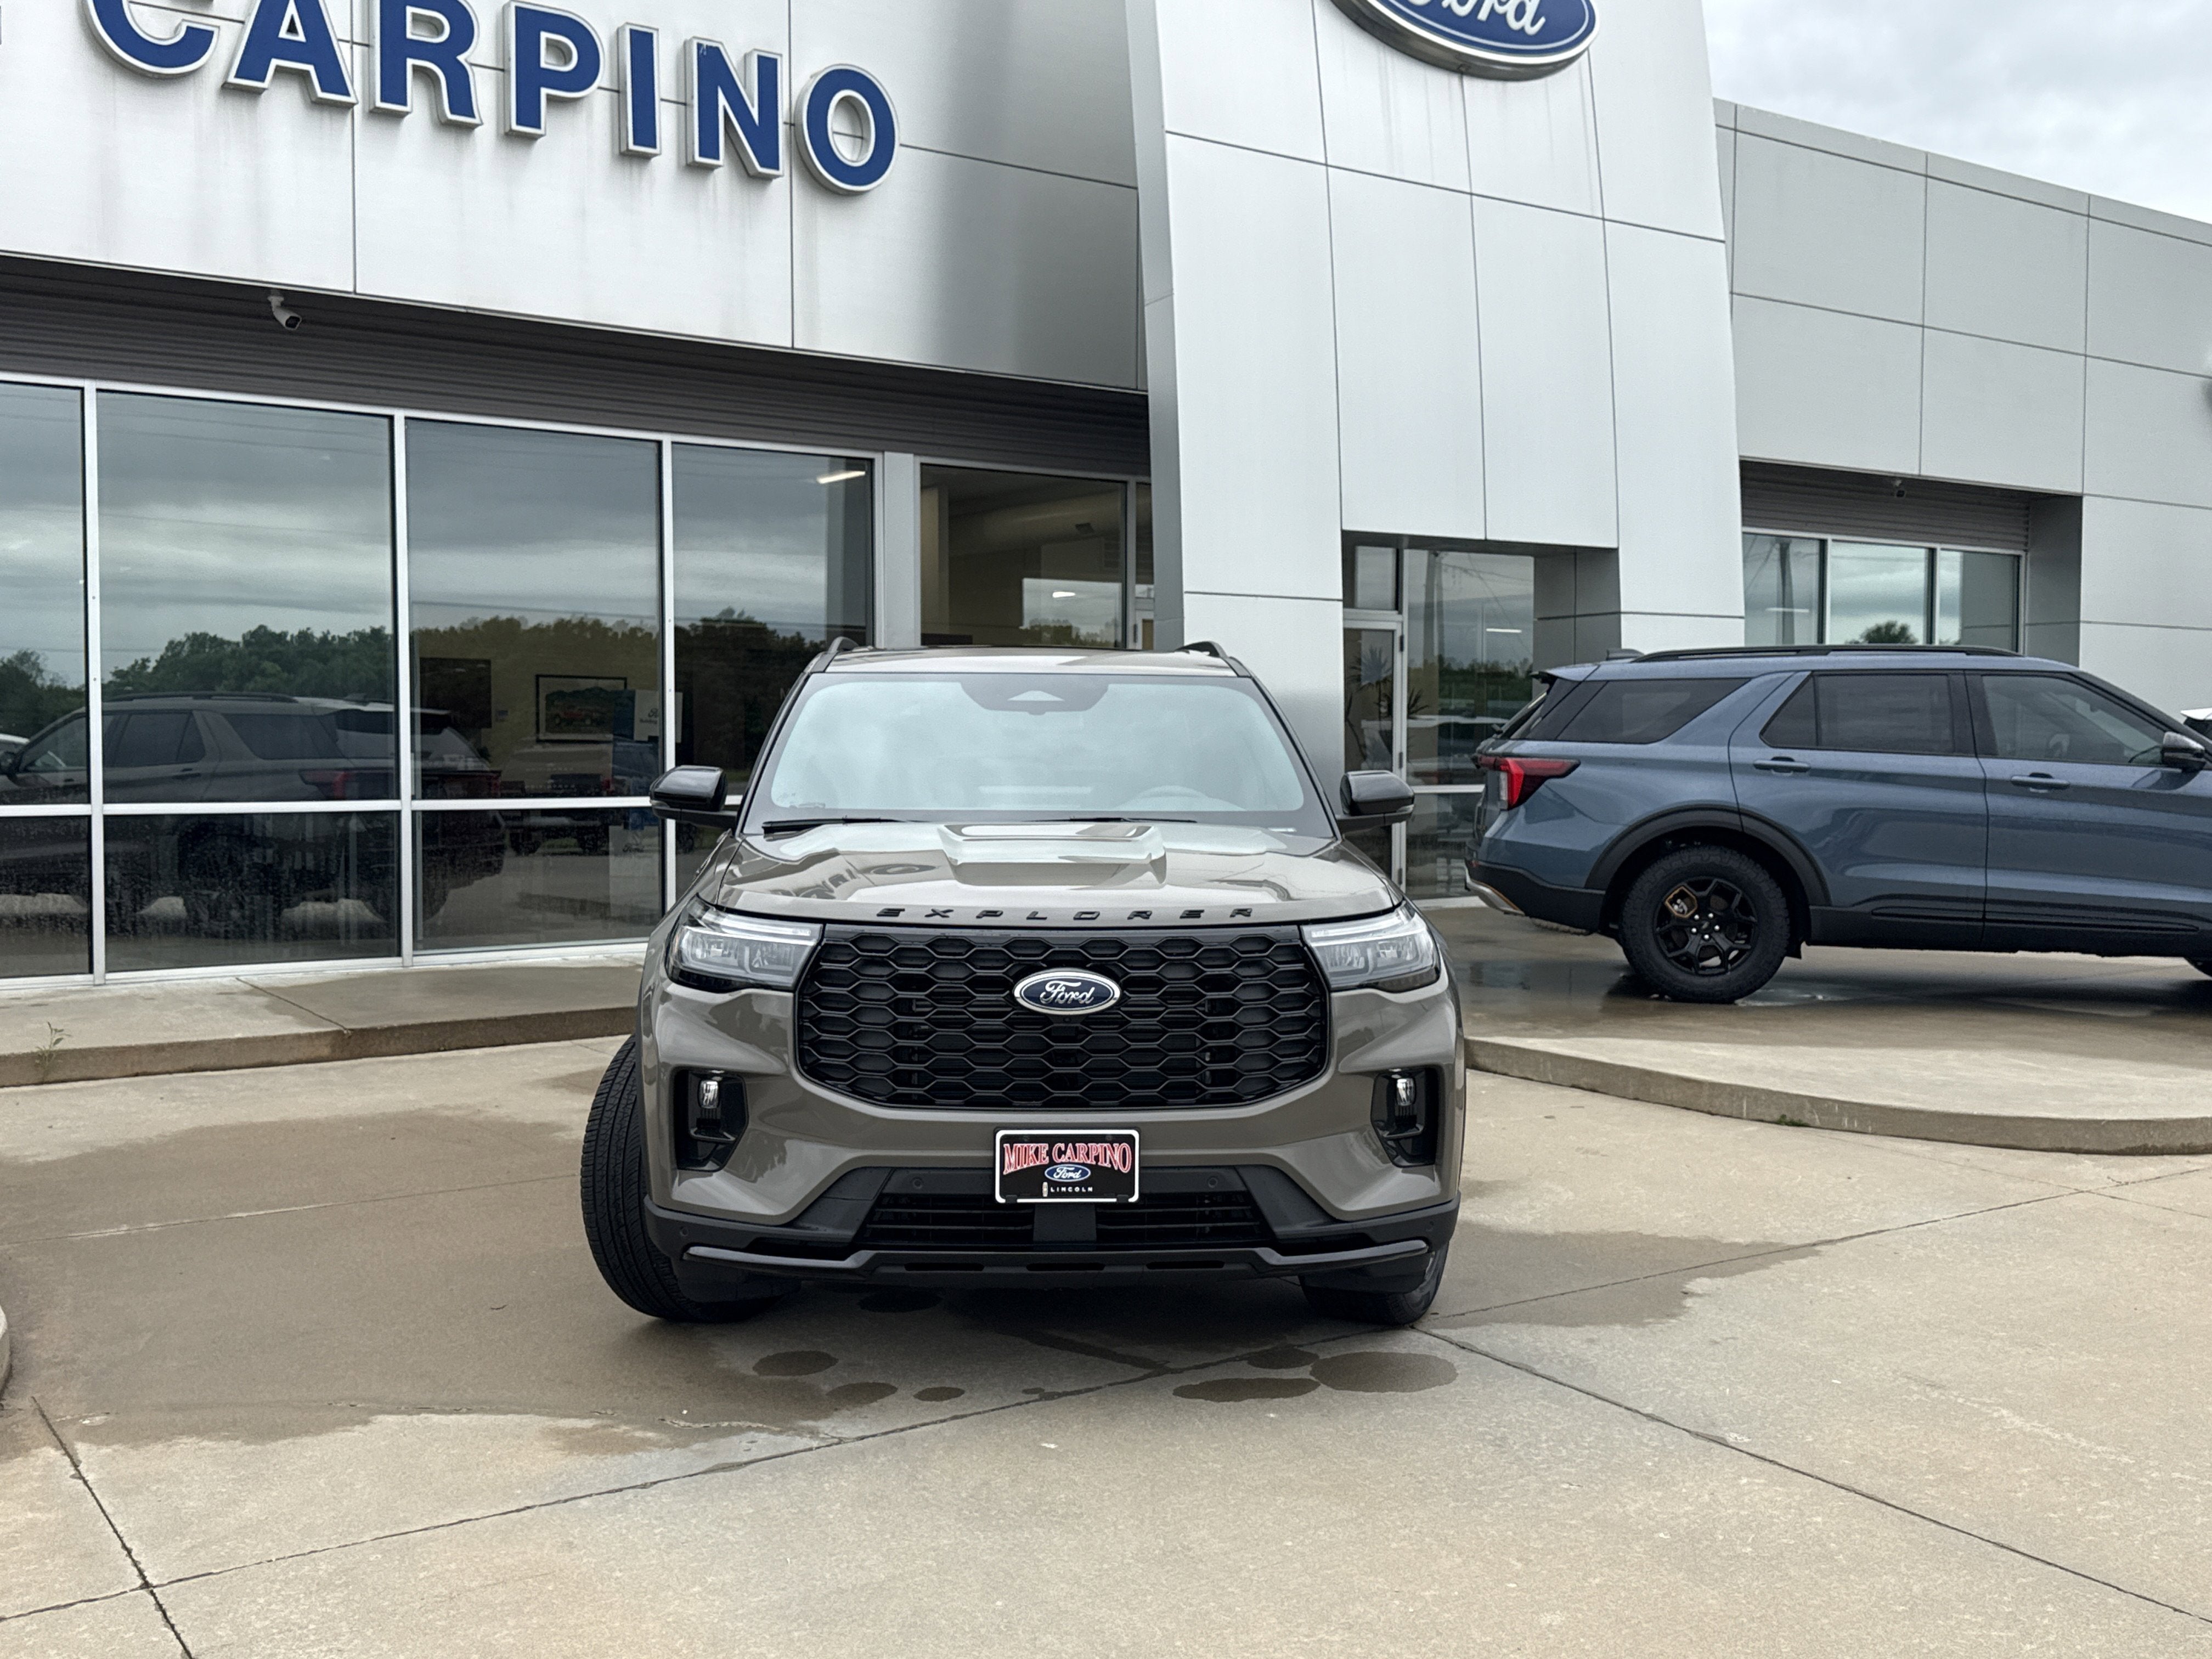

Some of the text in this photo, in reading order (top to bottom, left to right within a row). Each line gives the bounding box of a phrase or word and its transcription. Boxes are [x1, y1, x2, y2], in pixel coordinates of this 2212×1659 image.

[876, 907, 1253, 921] EXPLORER
[1039, 980, 1095, 1005] Ford
[1003, 1143, 1132, 1175] MIKE CARPINO
[1054, 1167, 1081, 1179] Ford
